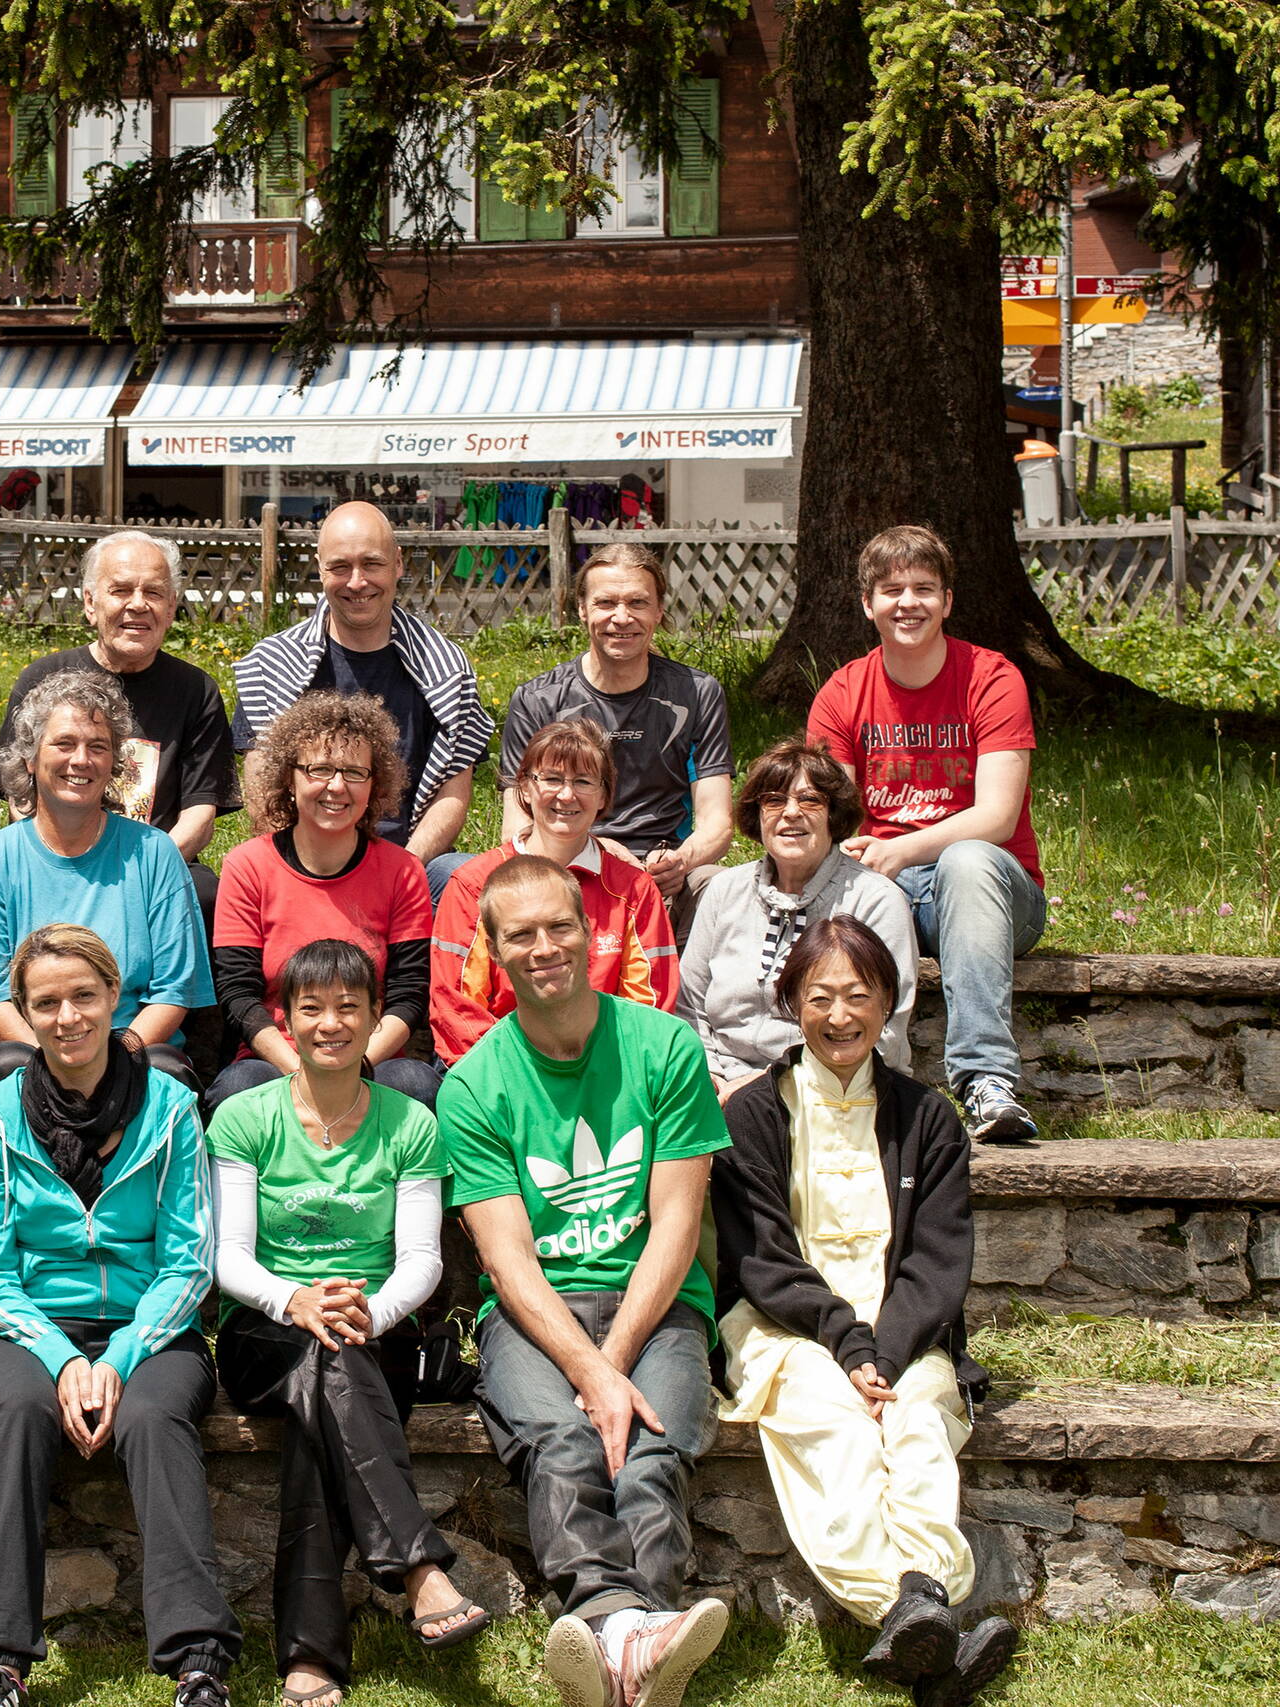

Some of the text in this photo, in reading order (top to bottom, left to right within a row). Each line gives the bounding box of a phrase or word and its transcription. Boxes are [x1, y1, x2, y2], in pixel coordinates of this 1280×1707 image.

[165, 436, 296, 454] INTERSPORT
[383, 433, 529, 457] Stäger Sport
[640, 429, 777, 448] INTERSPORT
